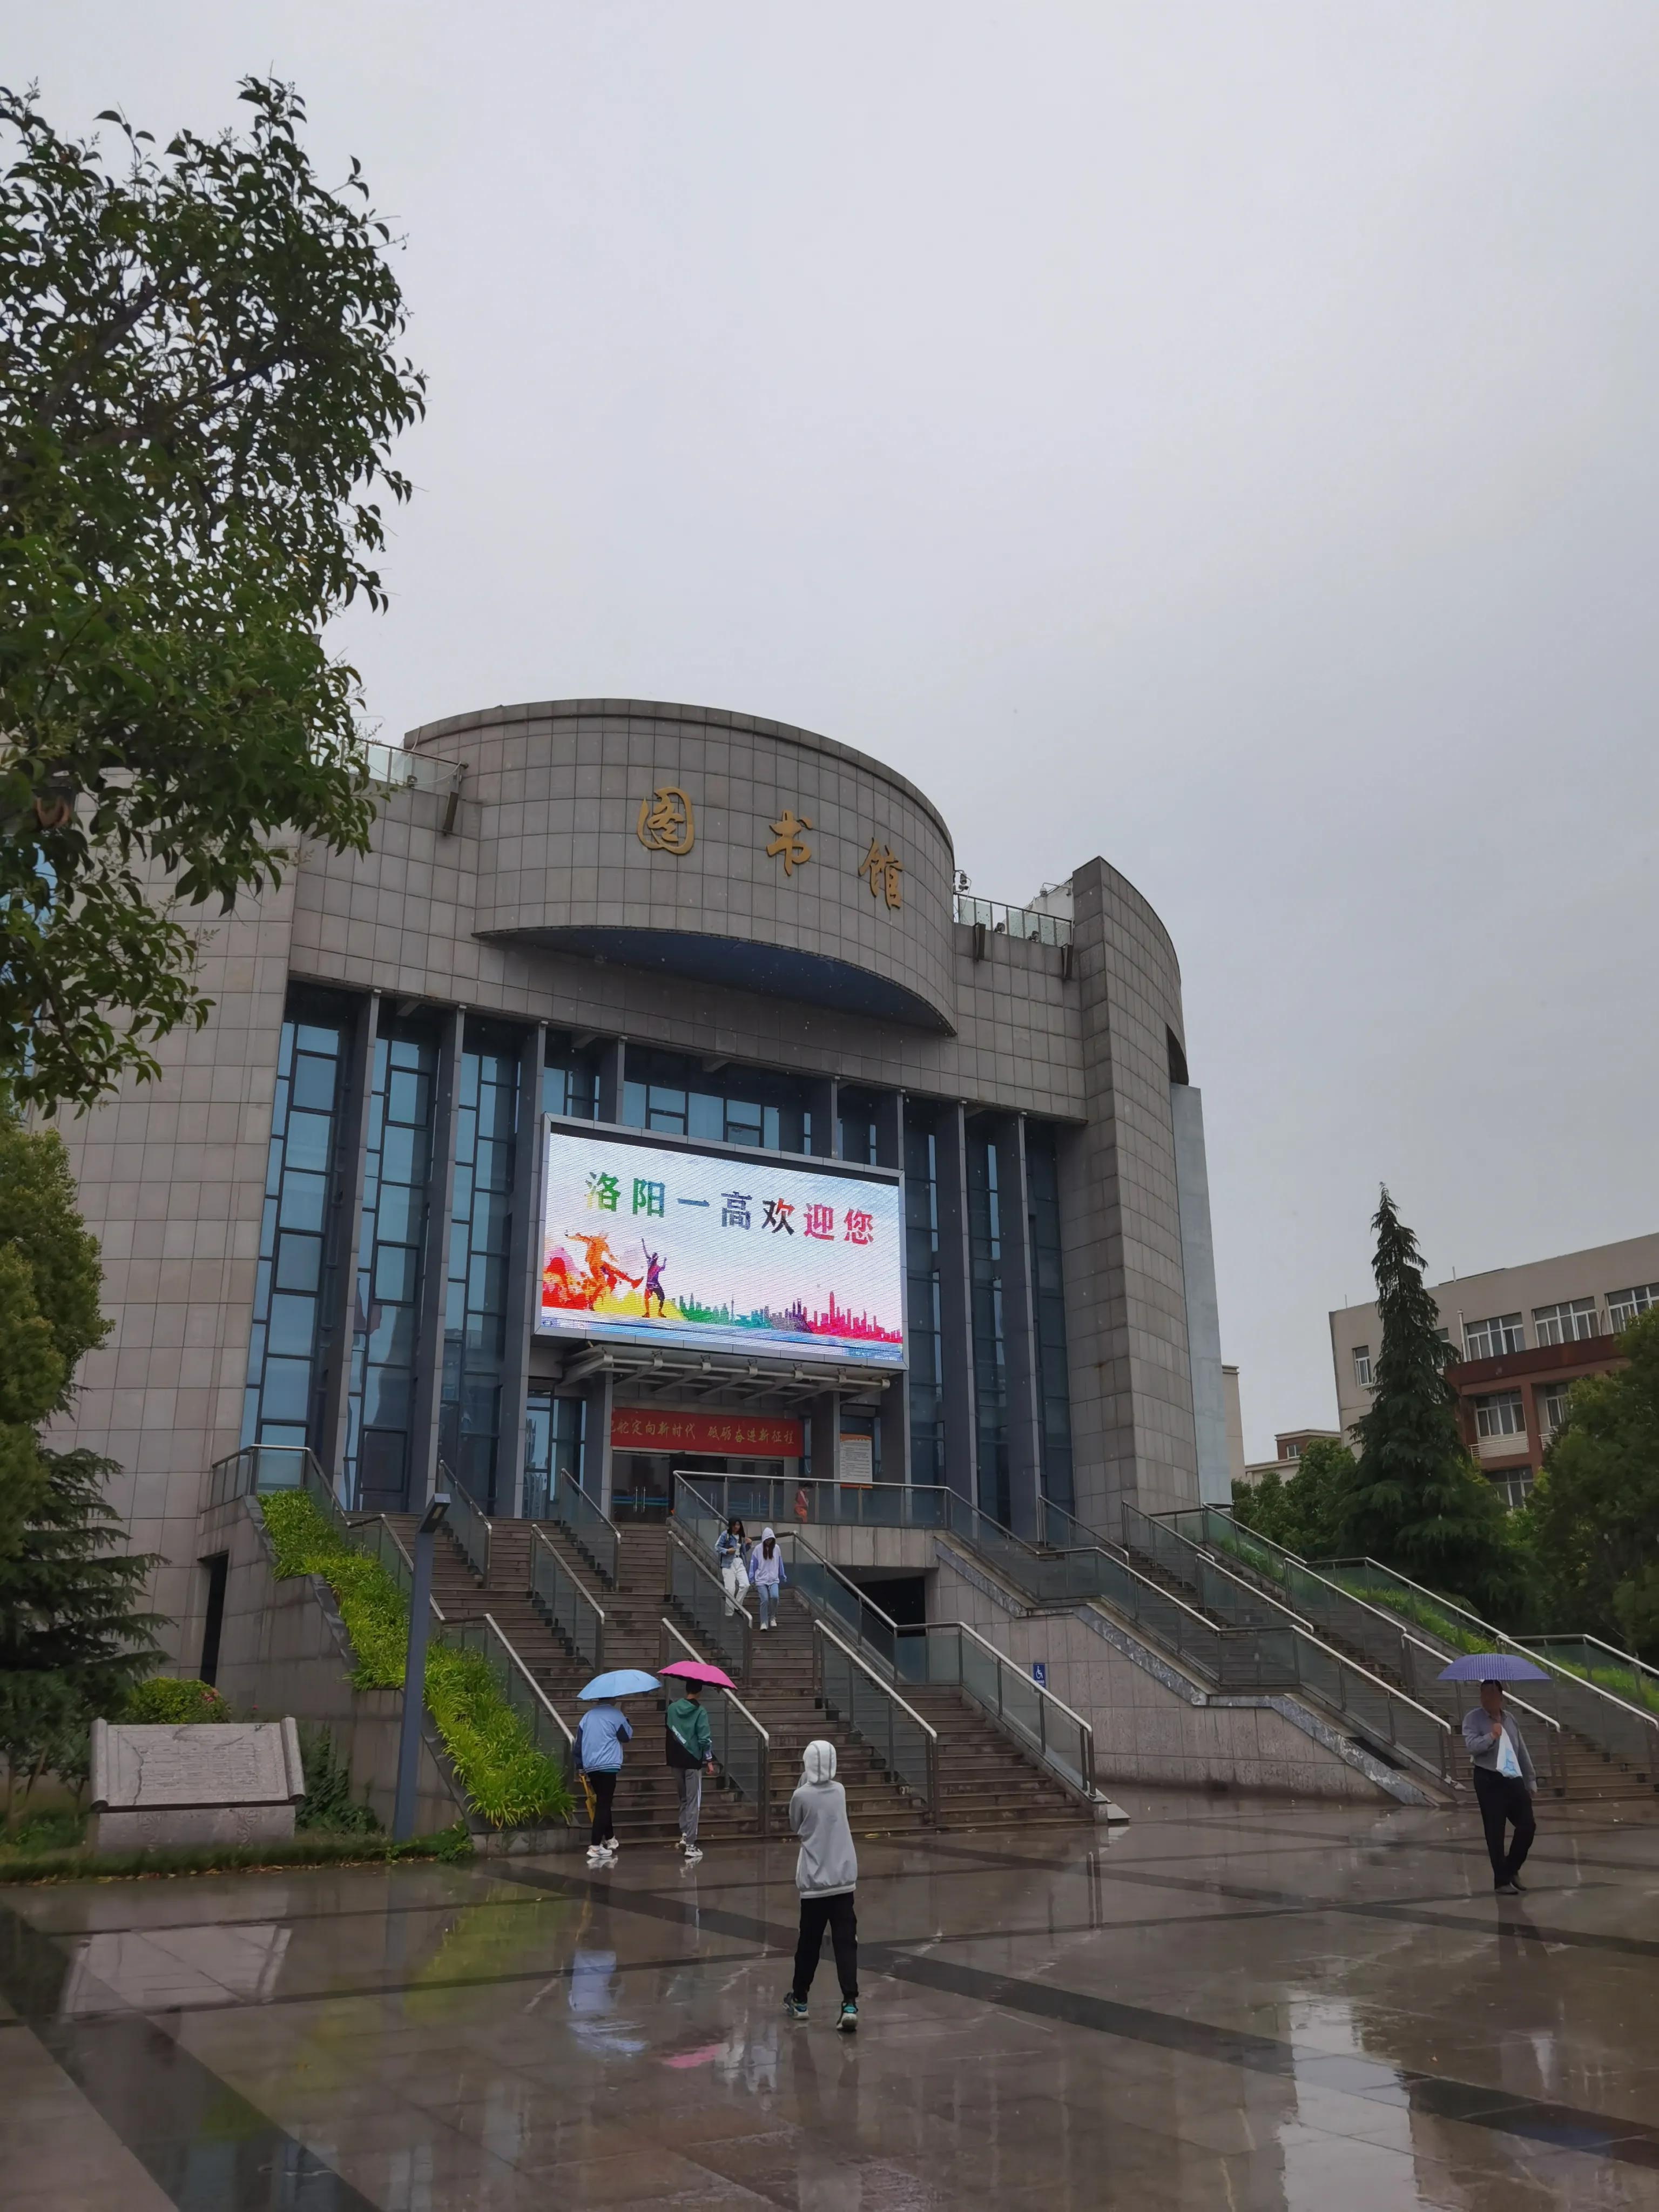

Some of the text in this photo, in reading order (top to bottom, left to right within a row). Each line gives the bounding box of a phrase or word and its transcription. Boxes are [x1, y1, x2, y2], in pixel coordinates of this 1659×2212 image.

[637, 786, 903, 910] 图书馆
[584, 1171, 874, 1245] 洛阳一高欢迎您
[707, 1425, 794, 1444] 砥砺奋进新征程
